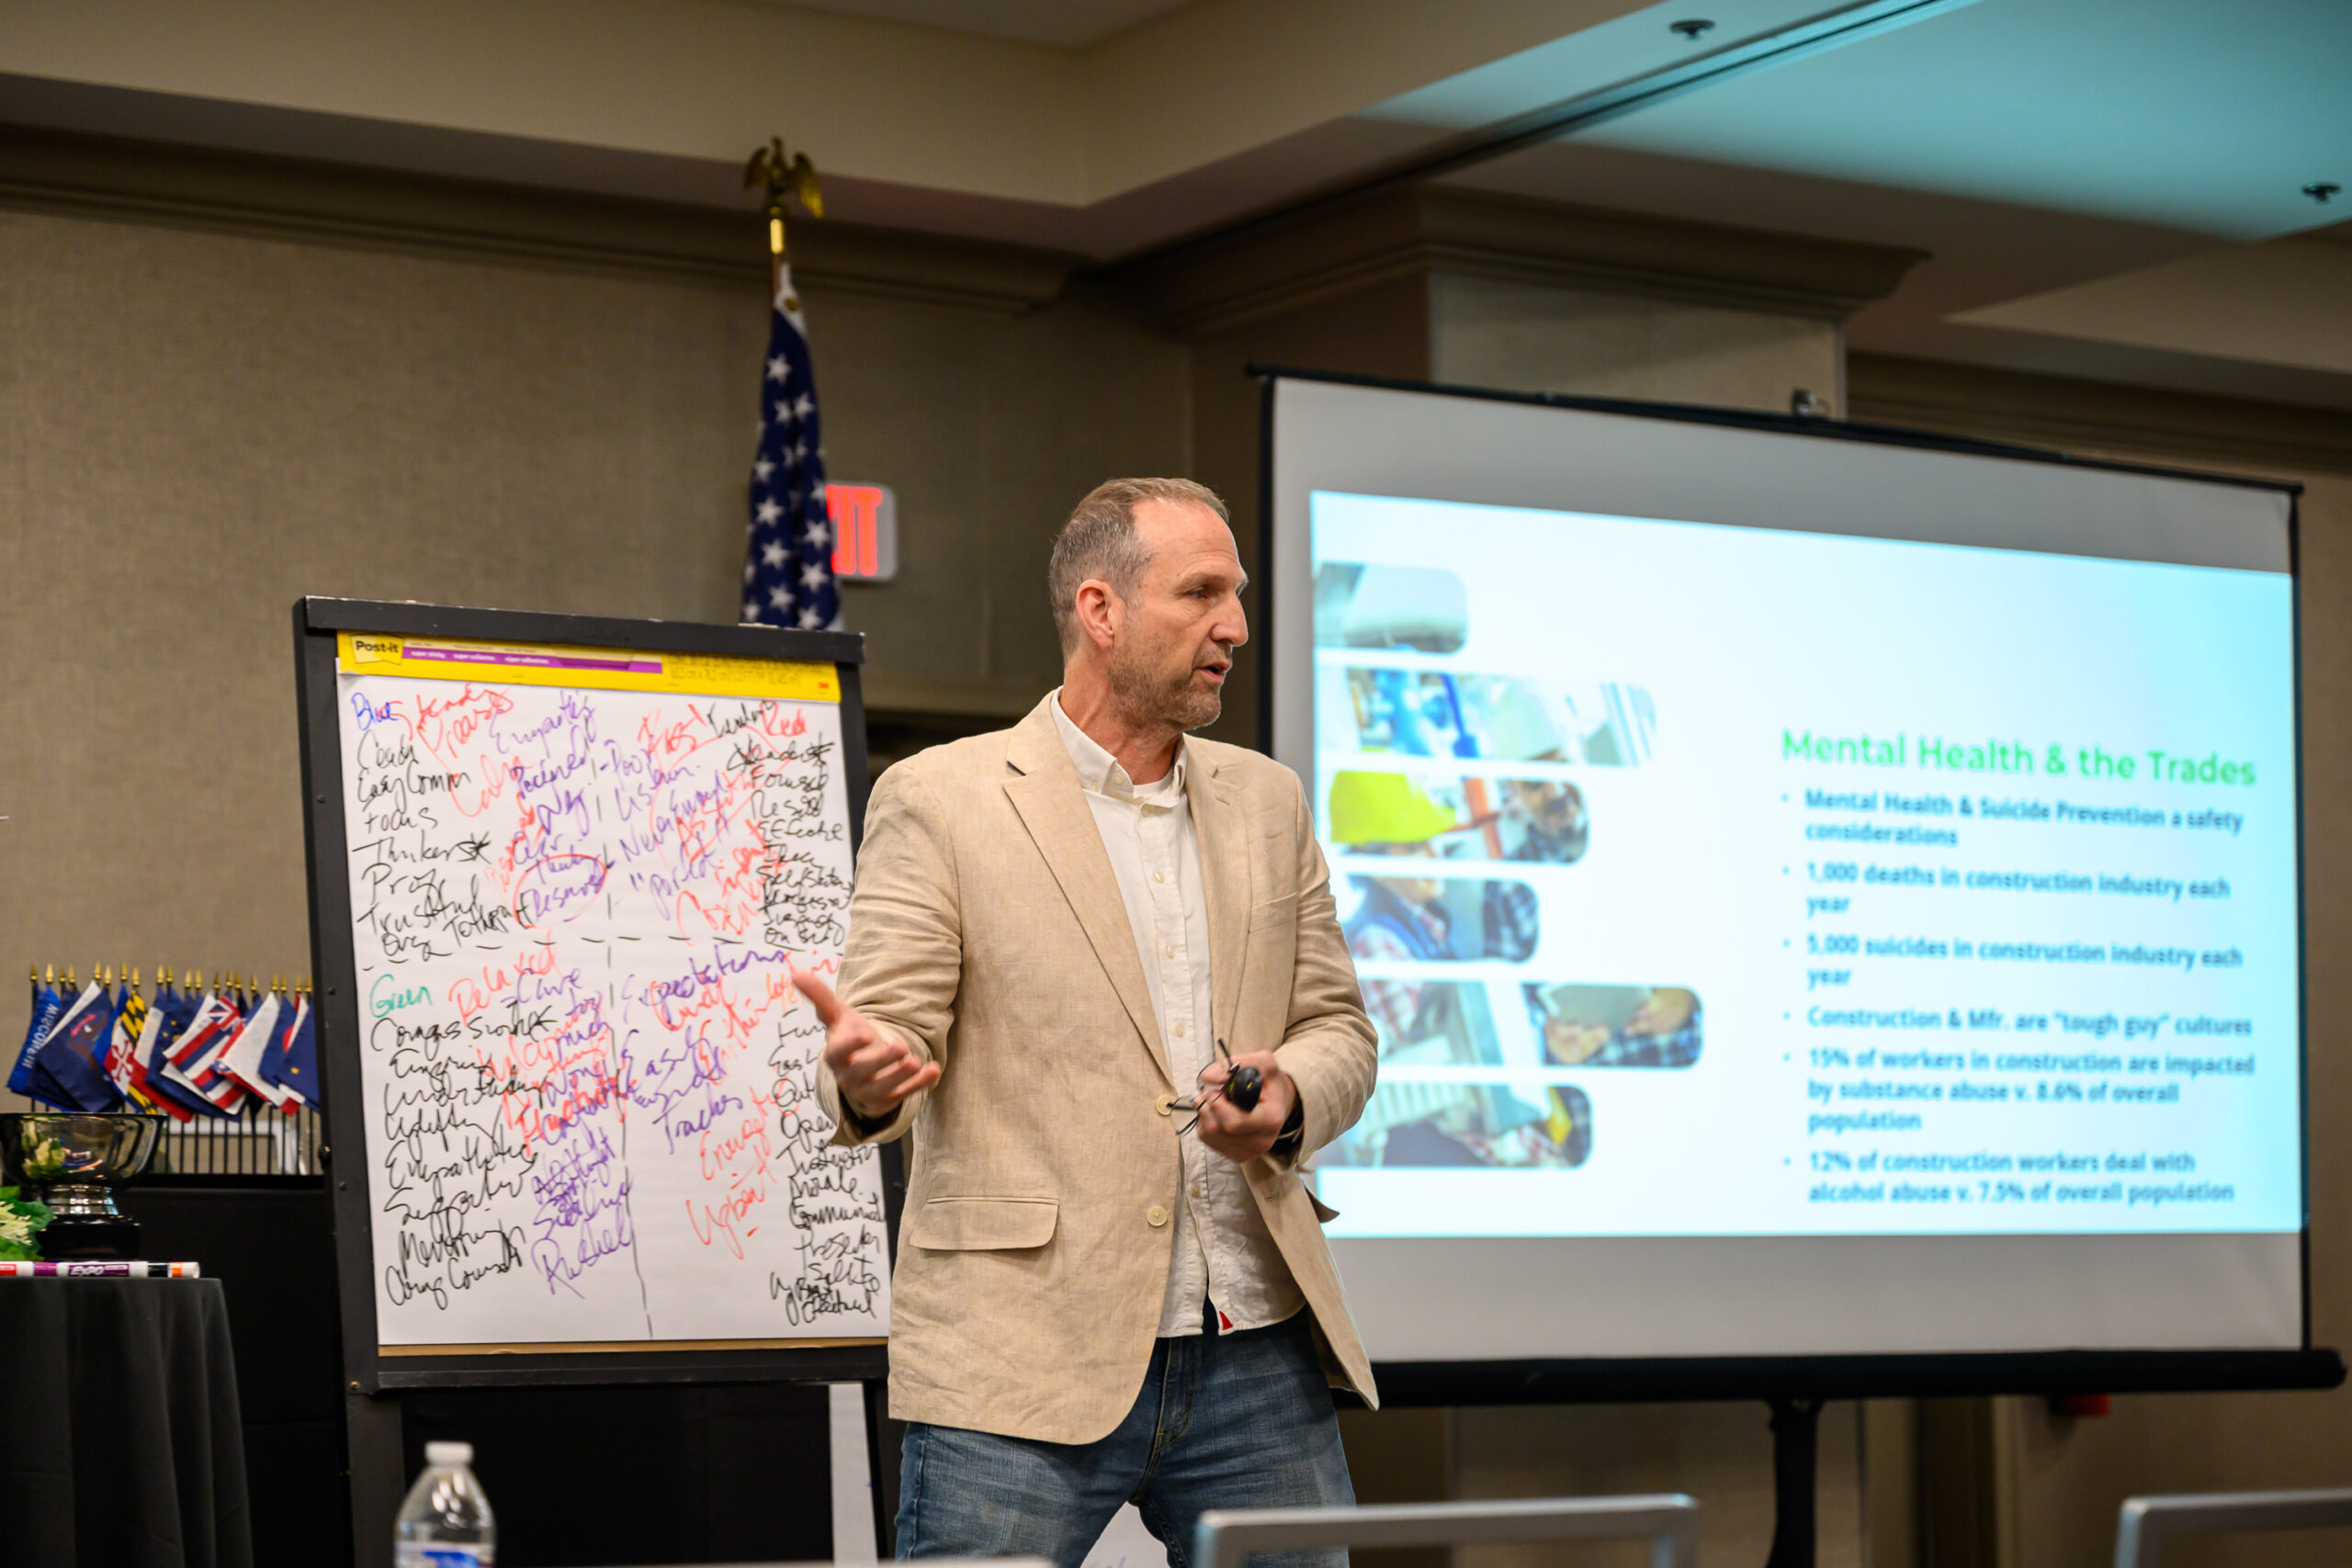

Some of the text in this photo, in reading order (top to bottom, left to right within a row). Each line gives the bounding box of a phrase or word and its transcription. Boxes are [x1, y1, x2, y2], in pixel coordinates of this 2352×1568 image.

[825, 484, 883, 577] IT
[356, 640, 400, 653] Post-it
[350, 693, 400, 731] Blue
[761, 700, 807, 738] Red
[1782, 729, 2256, 786] Mental Health & the Trades
[1805, 788, 2244, 838] Mental Health & Suicide Prevention a safety
[1805, 821, 1959, 847] considerations
[1807, 862, 2231, 904] 1,000 deaths in construction industry each
[1806, 896, 1850, 919] year
[1807, 932, 2244, 974] 5,000 suicides in construction industry each
[1807, 968, 1851, 991] year
[369, 974, 433, 1018] Green
[1807, 1005, 1942, 1029] Construction
[1947, 1008, 1962, 1030] &
[2015, 1016, 2048, 1032] are
[2174, 1013, 2253, 1037] cultures
[1856, 1046, 1876, 1068] of
[1881, 1049, 1965, 1070] workers
[1970, 1050, 1990, 1071] in
[1995, 1052, 2122, 1075] construction
[2128, 1056, 2159, 1075] are
[2165, 1053, 2256, 1079] impacted
[1807, 1078, 1833, 1105] by
[1839, 1078, 1943, 1100] substance
[1950, 1079, 2009, 1102] abuse
[2088, 1081, 2109, 1103] of
[2112, 1082, 2180, 1104] overall
[1807, 1110, 1923, 1135] population
[1858, 1149, 1878, 1172] of
[1883, 1150, 2014, 1172] construction
[2018, 1150, 2099, 1172] workers
[2104, 1151, 2147, 1173] deal
[2151, 1151, 2197, 1173] with
[1808, 1181, 1884, 1203] alcohol
[1890, 1182, 1952, 1203] abuse
[2030, 1181, 2052, 1204] of
[2056, 1181, 2123, 1204] overall
[2128, 1181, 2235, 1209] population
